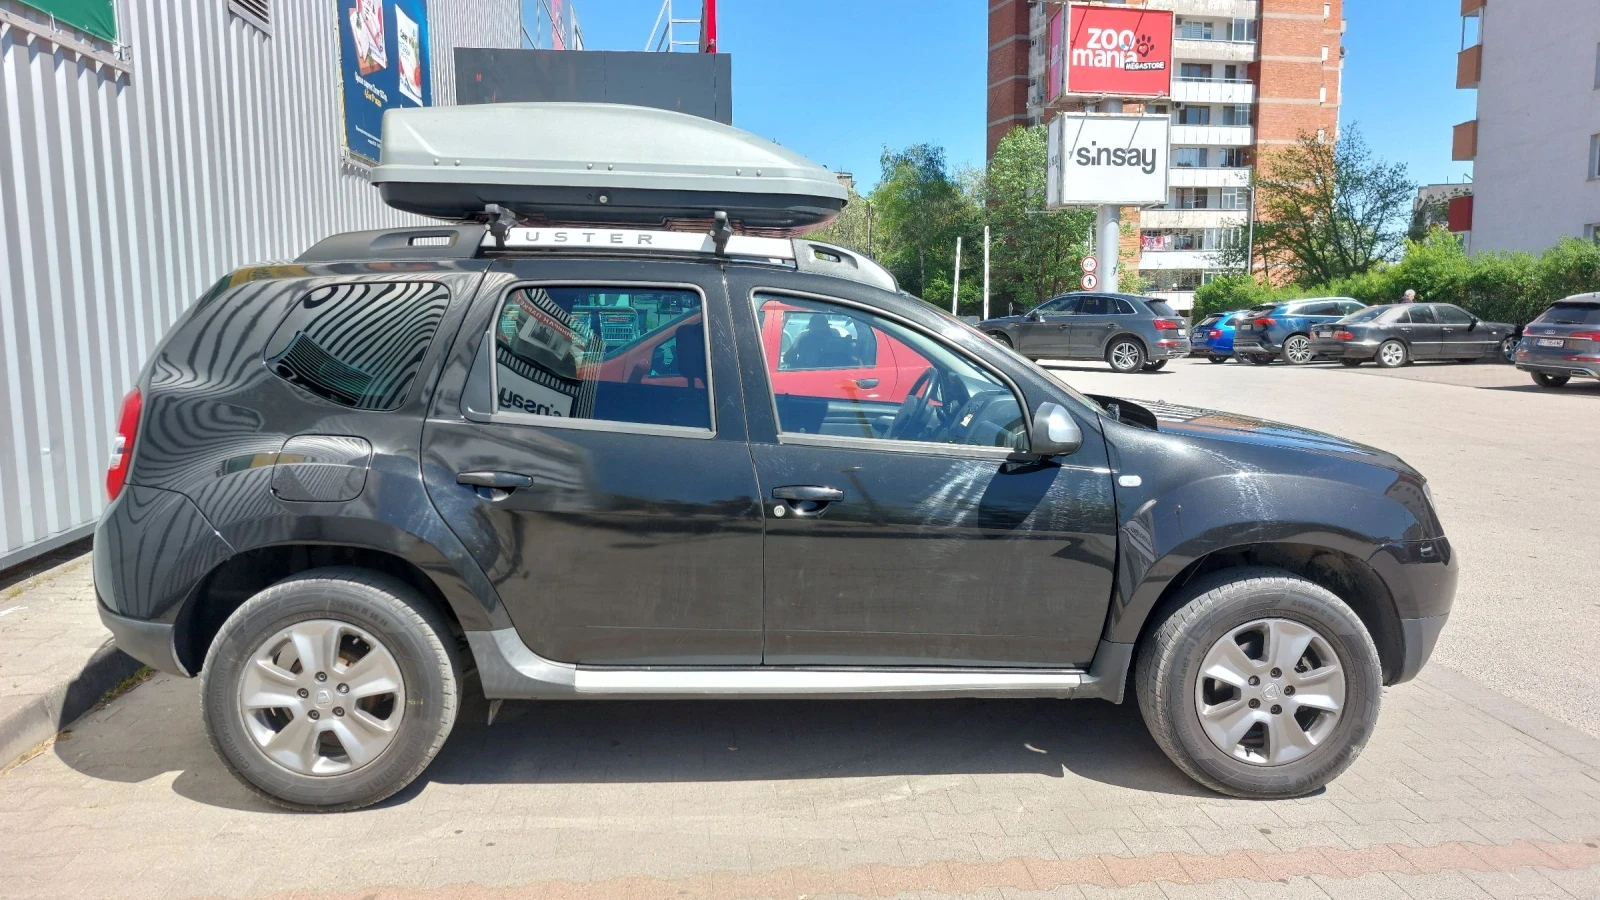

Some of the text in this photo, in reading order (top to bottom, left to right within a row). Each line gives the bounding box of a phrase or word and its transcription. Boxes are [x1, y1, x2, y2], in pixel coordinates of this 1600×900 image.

[1087, 28, 1136, 51] zoo
[1072, 48, 1138, 69] mania
[1125, 62, 1165, 70] MEGASTORE
[1076, 141, 1157, 175] sinsay
[504, 231, 653, 245] USTER
